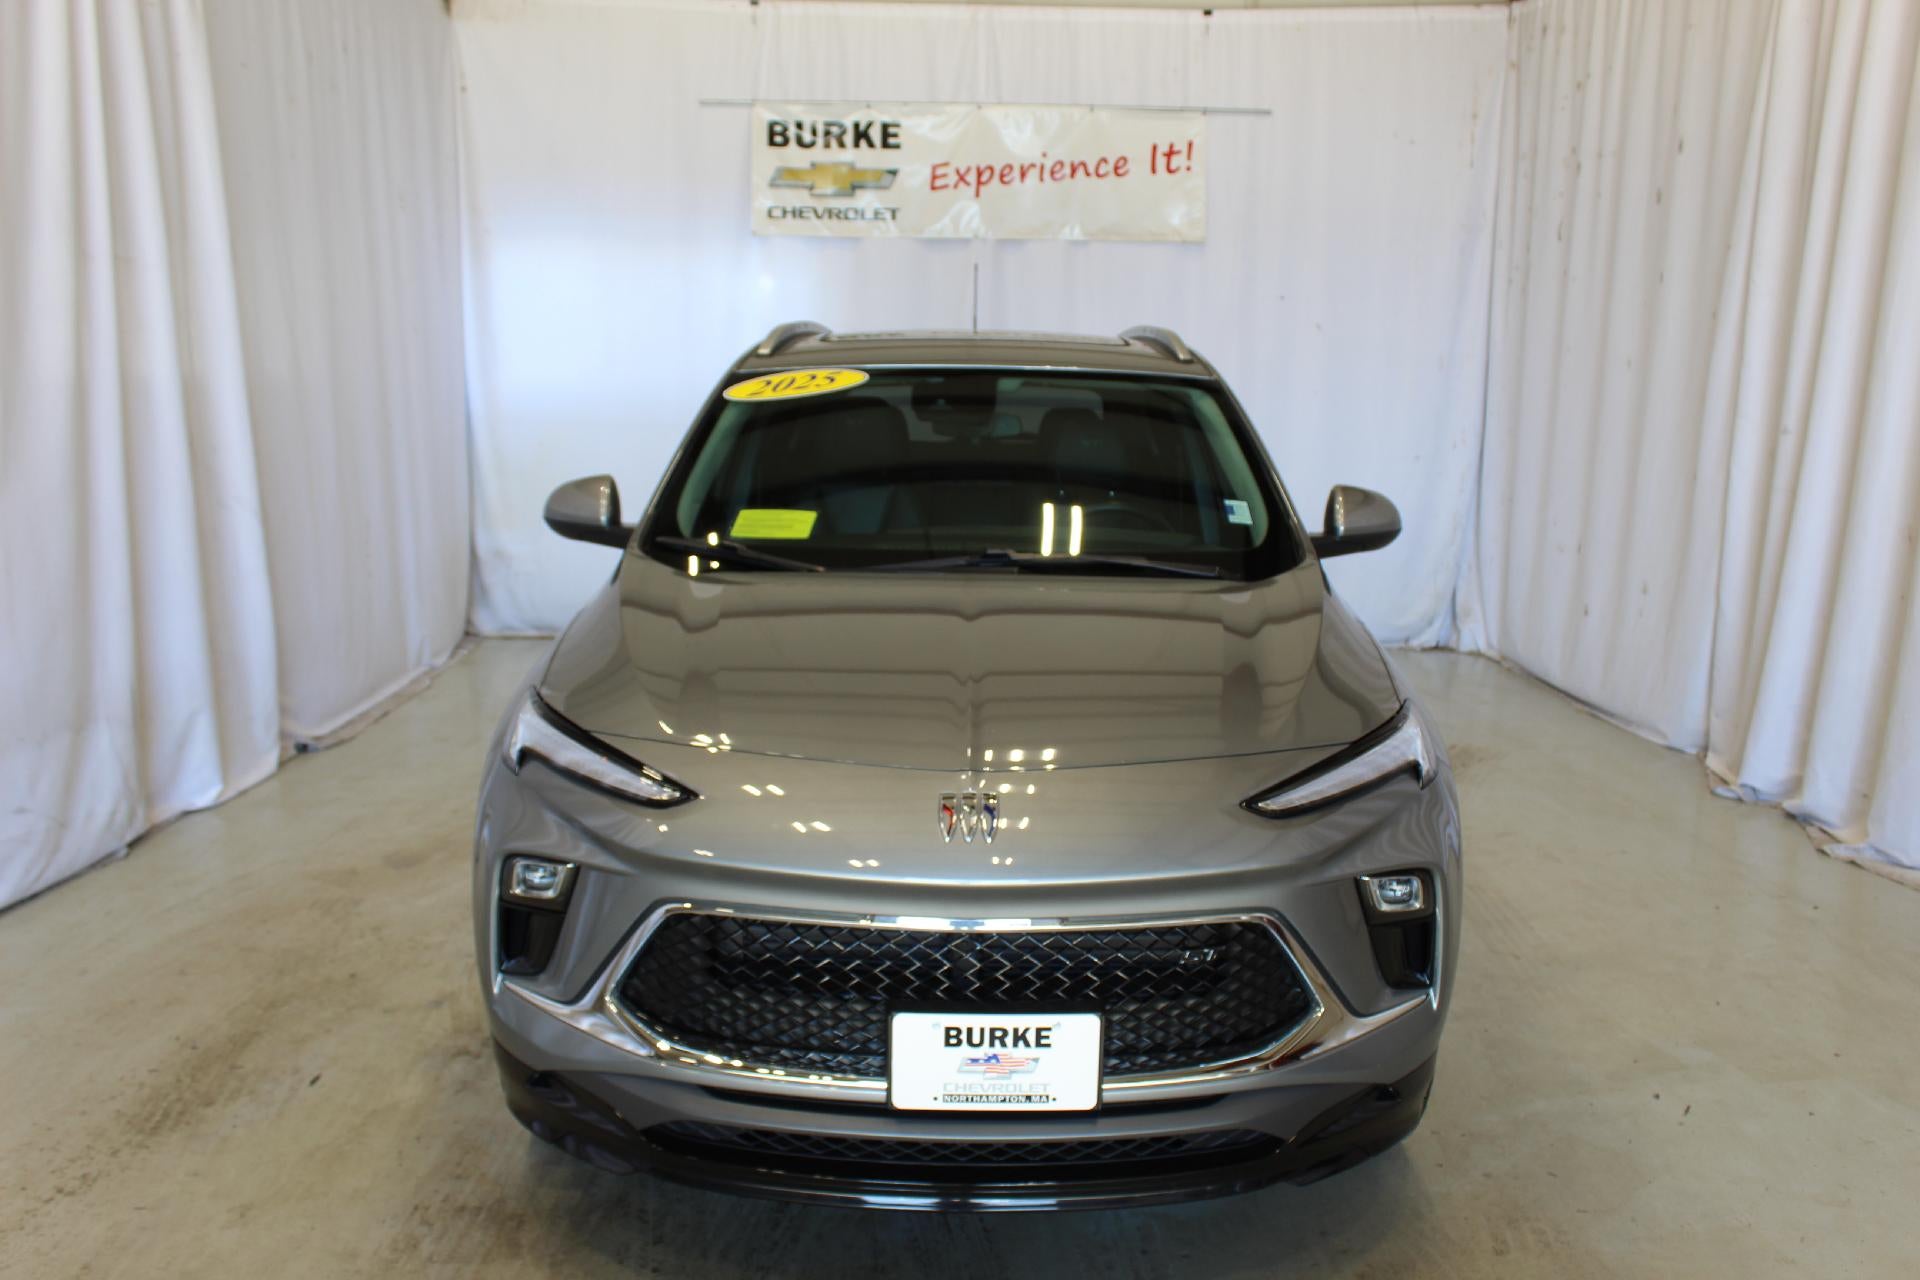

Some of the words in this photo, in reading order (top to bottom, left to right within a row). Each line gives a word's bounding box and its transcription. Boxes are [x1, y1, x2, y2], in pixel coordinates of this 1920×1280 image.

[768, 120, 901, 149] BURKE
[929, 154, 1129, 198] Experience
[1149, 140, 1195, 175] It!
[767, 206, 900, 221] CHEVROLET
[747, 371, 841, 396] 2025
[944, 1027, 1052, 1048] BURKE
[943, 1082, 1050, 1093] CHEVROLET
